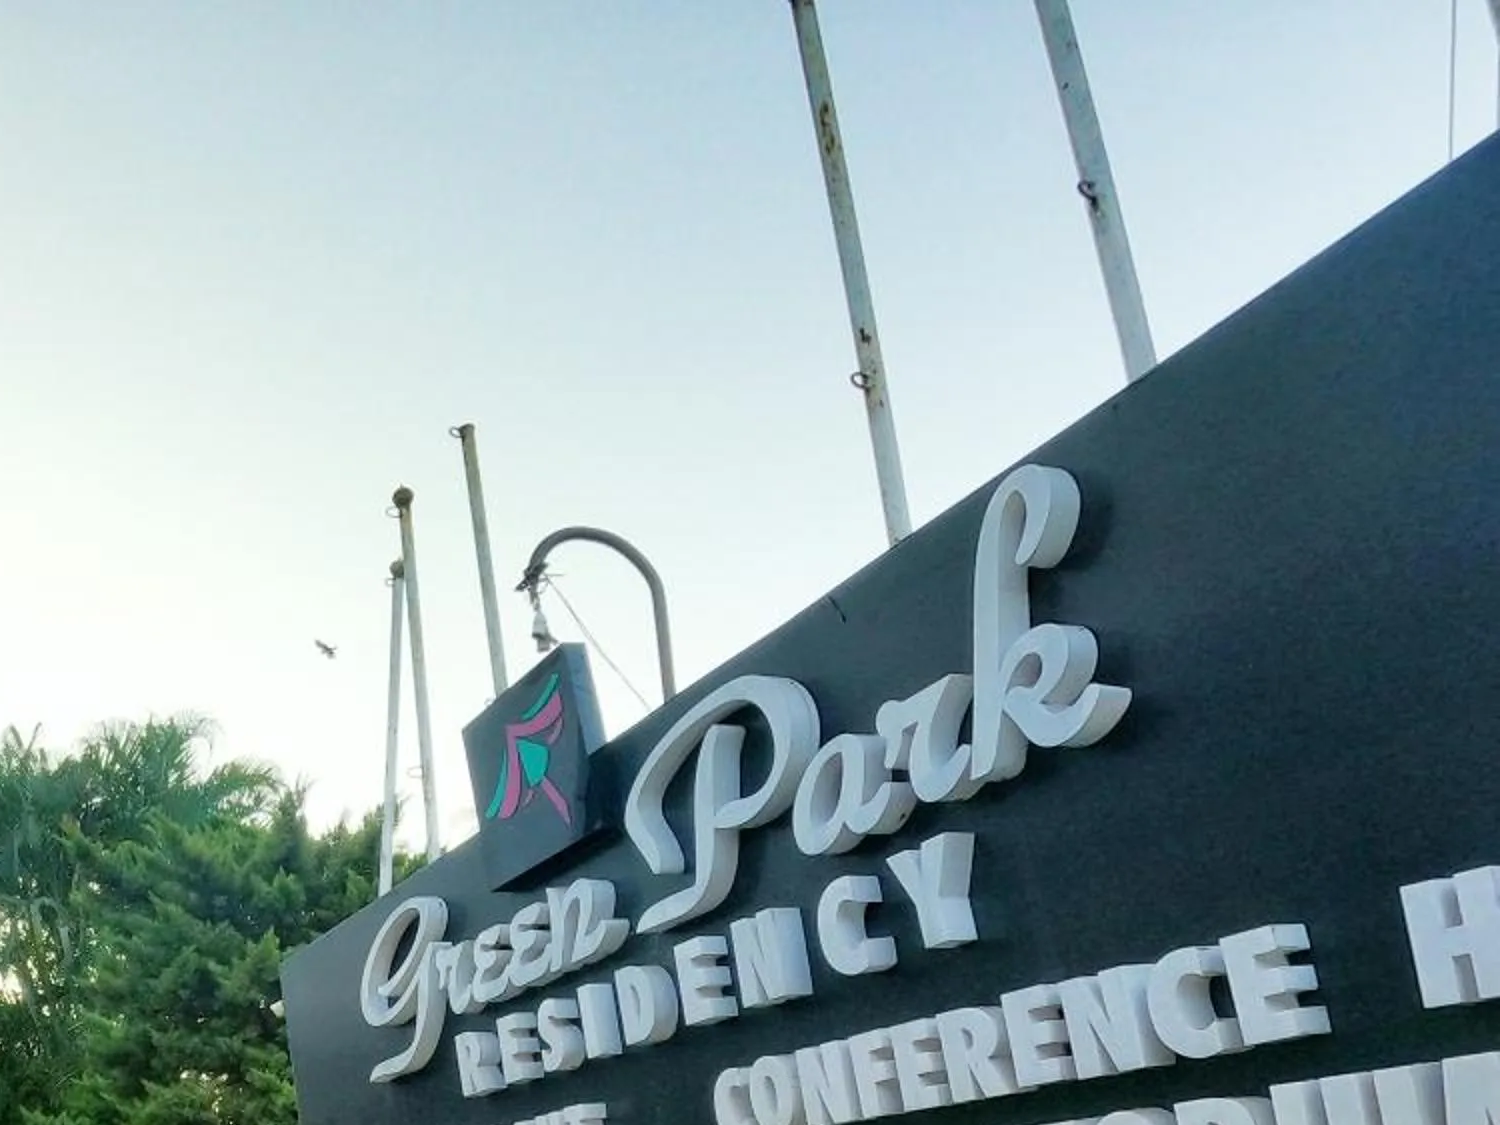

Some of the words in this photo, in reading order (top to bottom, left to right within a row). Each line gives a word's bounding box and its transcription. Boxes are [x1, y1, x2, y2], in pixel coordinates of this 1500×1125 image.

[360, 879, 628, 1084] Green
[625, 463, 1133, 934] Park
[454, 832, 979, 1098] RESIDENCY
